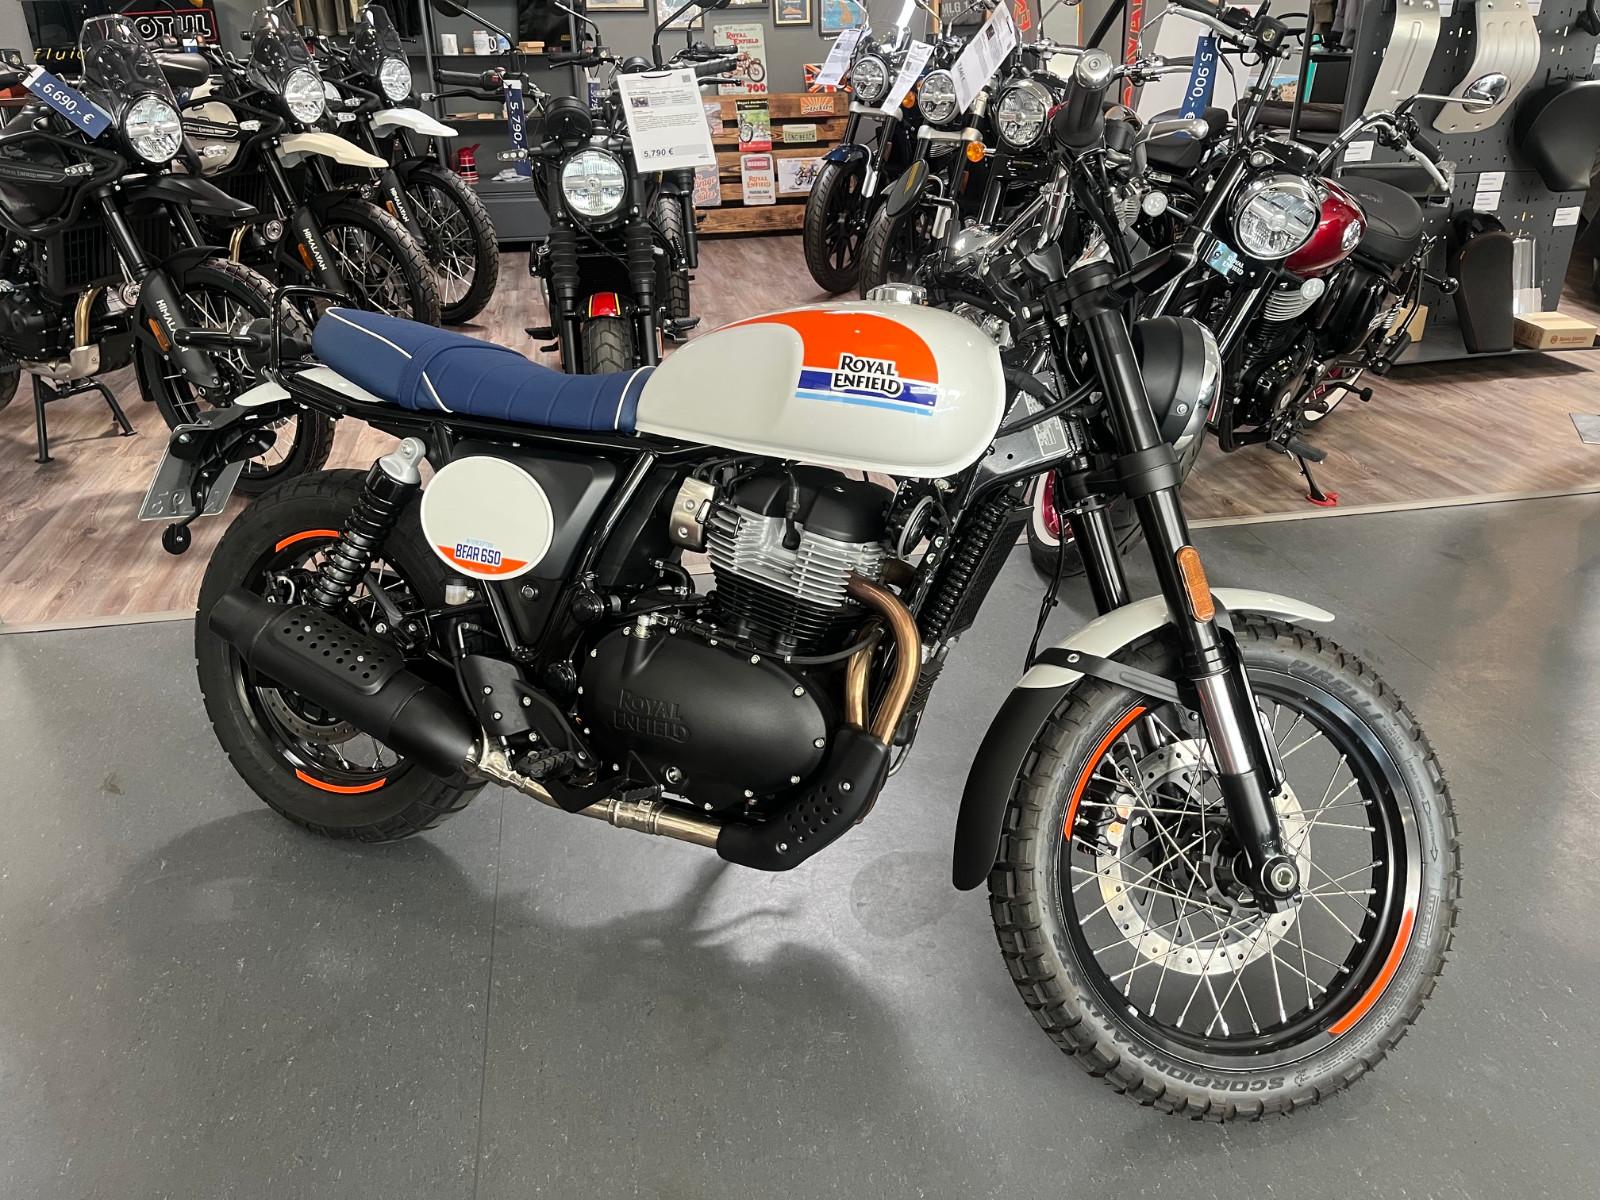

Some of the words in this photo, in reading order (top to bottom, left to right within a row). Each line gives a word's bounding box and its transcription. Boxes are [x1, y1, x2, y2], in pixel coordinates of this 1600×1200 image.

[726, 32, 748, 40] ROYAL
[746, 83, 766, 92] 700
[1189, 52, 1212, 107] 5.900,-
[42, 83, 82, 115] 6.690,-
[83, 112, 95, 125] €
[643, 148, 667, 158] 5.790
[390, 187, 411, 223] HIMALAYAN
[302, 228, 327, 272] HIMALAYAN
[156, 299, 189, 353] HIMALN
[840, 355, 895, 376] ROYAL
[833, 373, 901, 395] ENFIELD
[481, 548, 501, 565] 650
[617, 688, 682, 721] ROYAL
[1288, 659, 1384, 721] PIRELLI
[611, 710, 692, 744] ENFIELD
[1143, 1056, 1285, 1092] SCORPION
